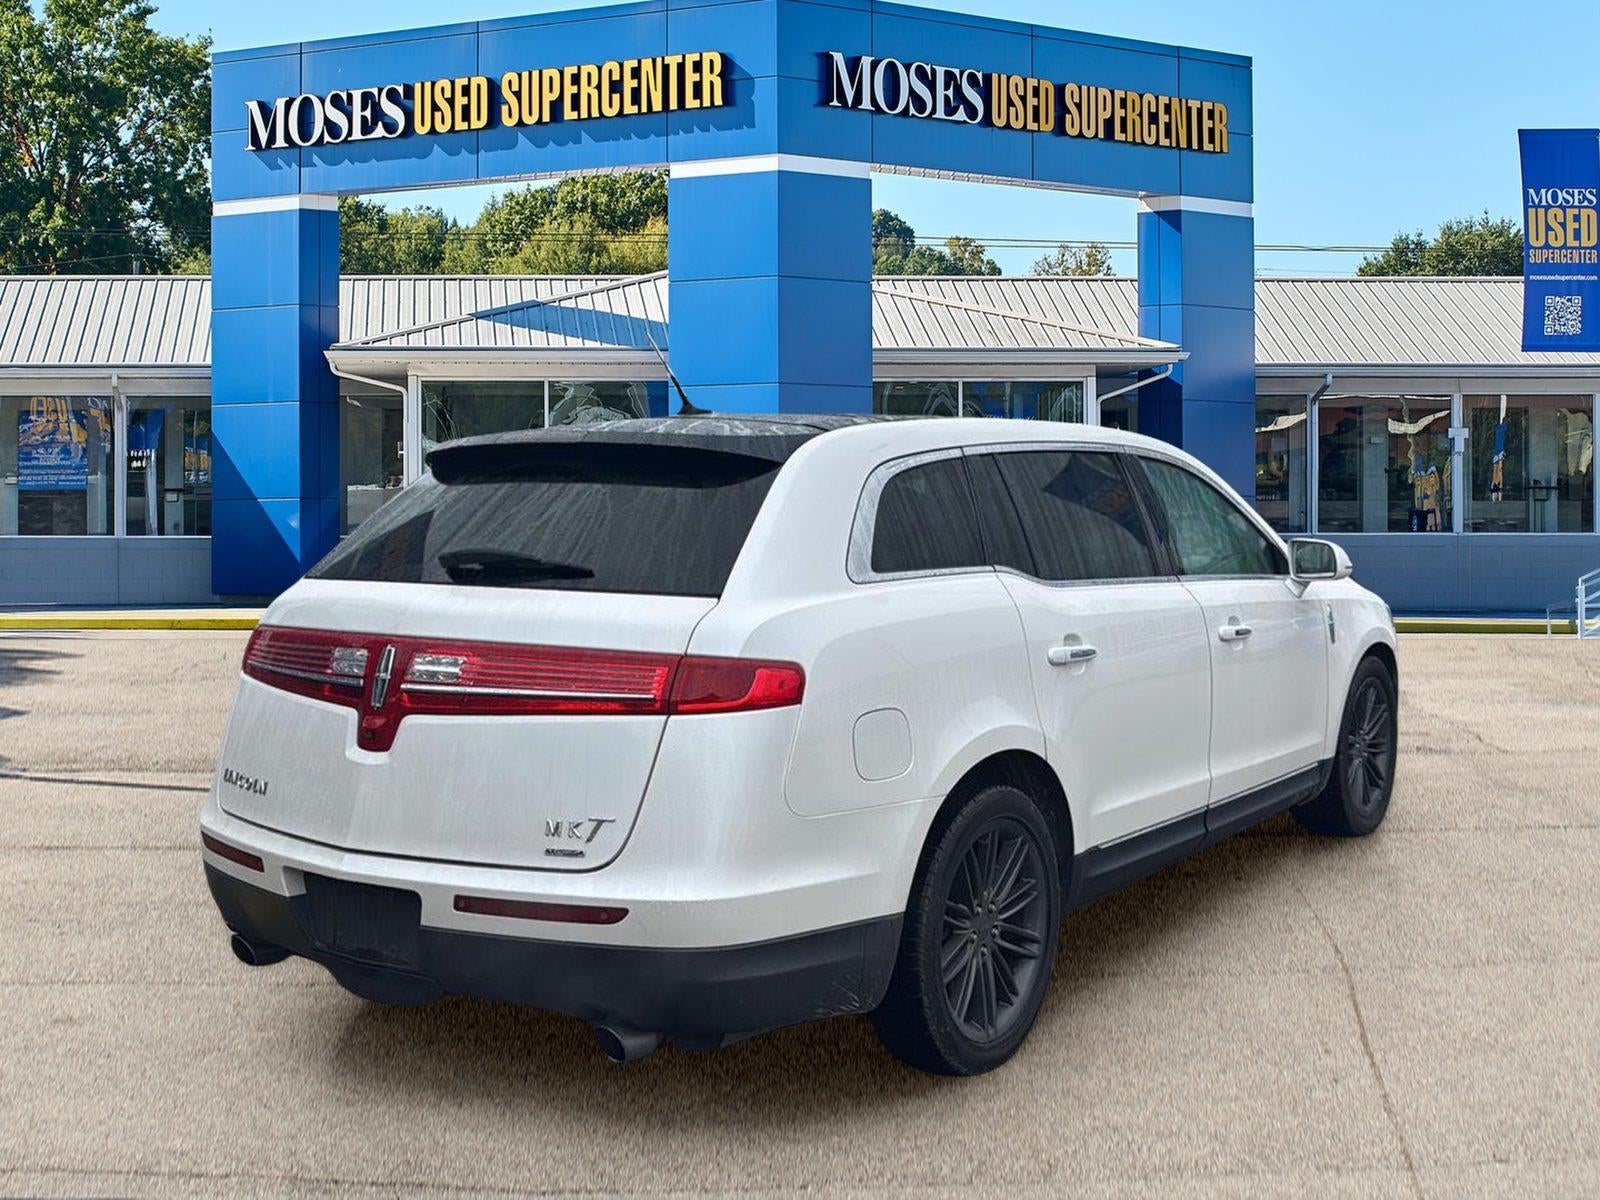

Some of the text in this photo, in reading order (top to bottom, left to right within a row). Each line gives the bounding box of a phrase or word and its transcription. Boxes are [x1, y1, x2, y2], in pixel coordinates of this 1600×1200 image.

[244, 51, 724, 151] MOSES USED SUPERCENTER
[828, 51, 1229, 153] MOSES USED SUPERCENTER
[1527, 188, 1597, 207] MOSES
[1528, 207, 1598, 247] USED
[1529, 249, 1598, 264] SUPERCENTER
